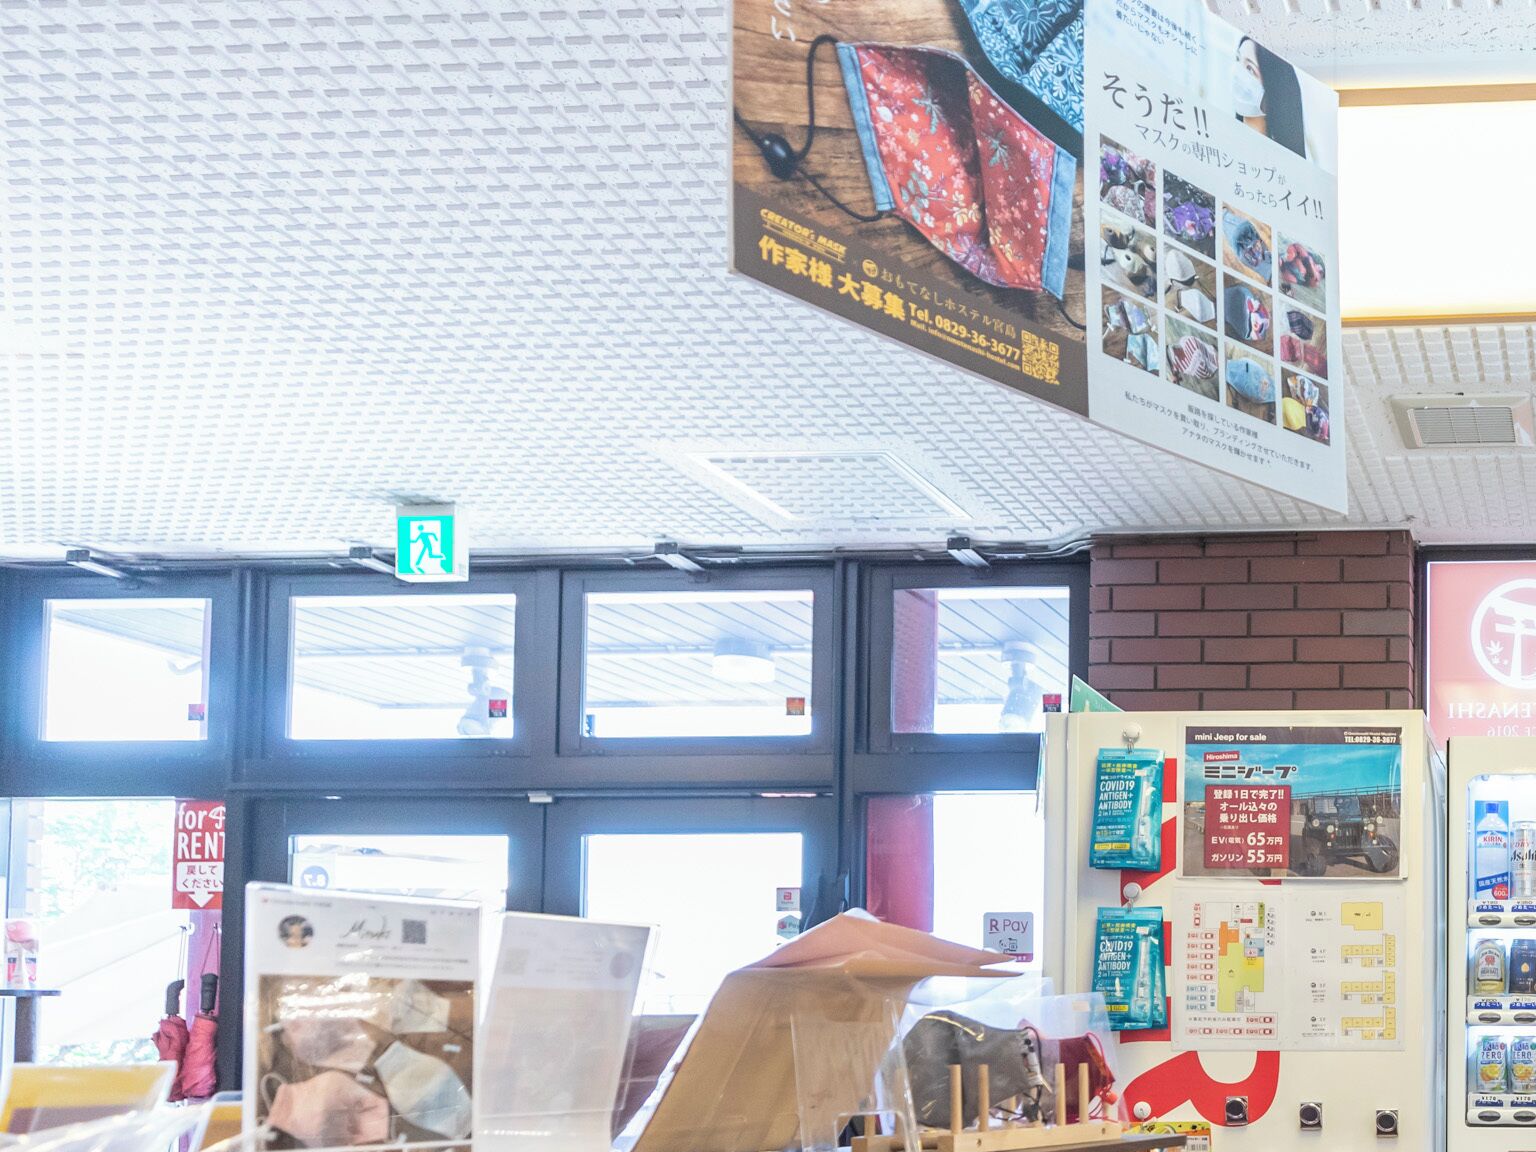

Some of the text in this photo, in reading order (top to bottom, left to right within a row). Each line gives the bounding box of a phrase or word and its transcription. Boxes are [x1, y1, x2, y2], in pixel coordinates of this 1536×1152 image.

[1135, 123, 1287, 186] マスクの専門ショップが
[758, 234, 906, 322] 作家様 大募集
[908, 301, 1021, 361] Tel. 0829-36-3677
[1194, 733, 1267, 742] mini Jeep for sale
[1206, 752, 1238, 761] Hiroshima
[1203, 764, 1298, 779] ミニジープ
[1099, 780, 1135, 792] COVID19
[1099, 791, 1134, 801] ANTIGEN+
[1098, 800, 1133, 811] ANTIBODY
[177, 802, 208, 830] for
[1219, 813, 1277, 823] 乗り出し価格
[1483, 835, 1503, 843] KIRIN
[1211, 852, 1244, 862] ガソリン
[186, 865, 219, 876] 戻して
[182, 878, 224, 890] ください
[1002, 918, 1029, 933] Pay
[1097, 961, 1131, 971] ANTIBODY
